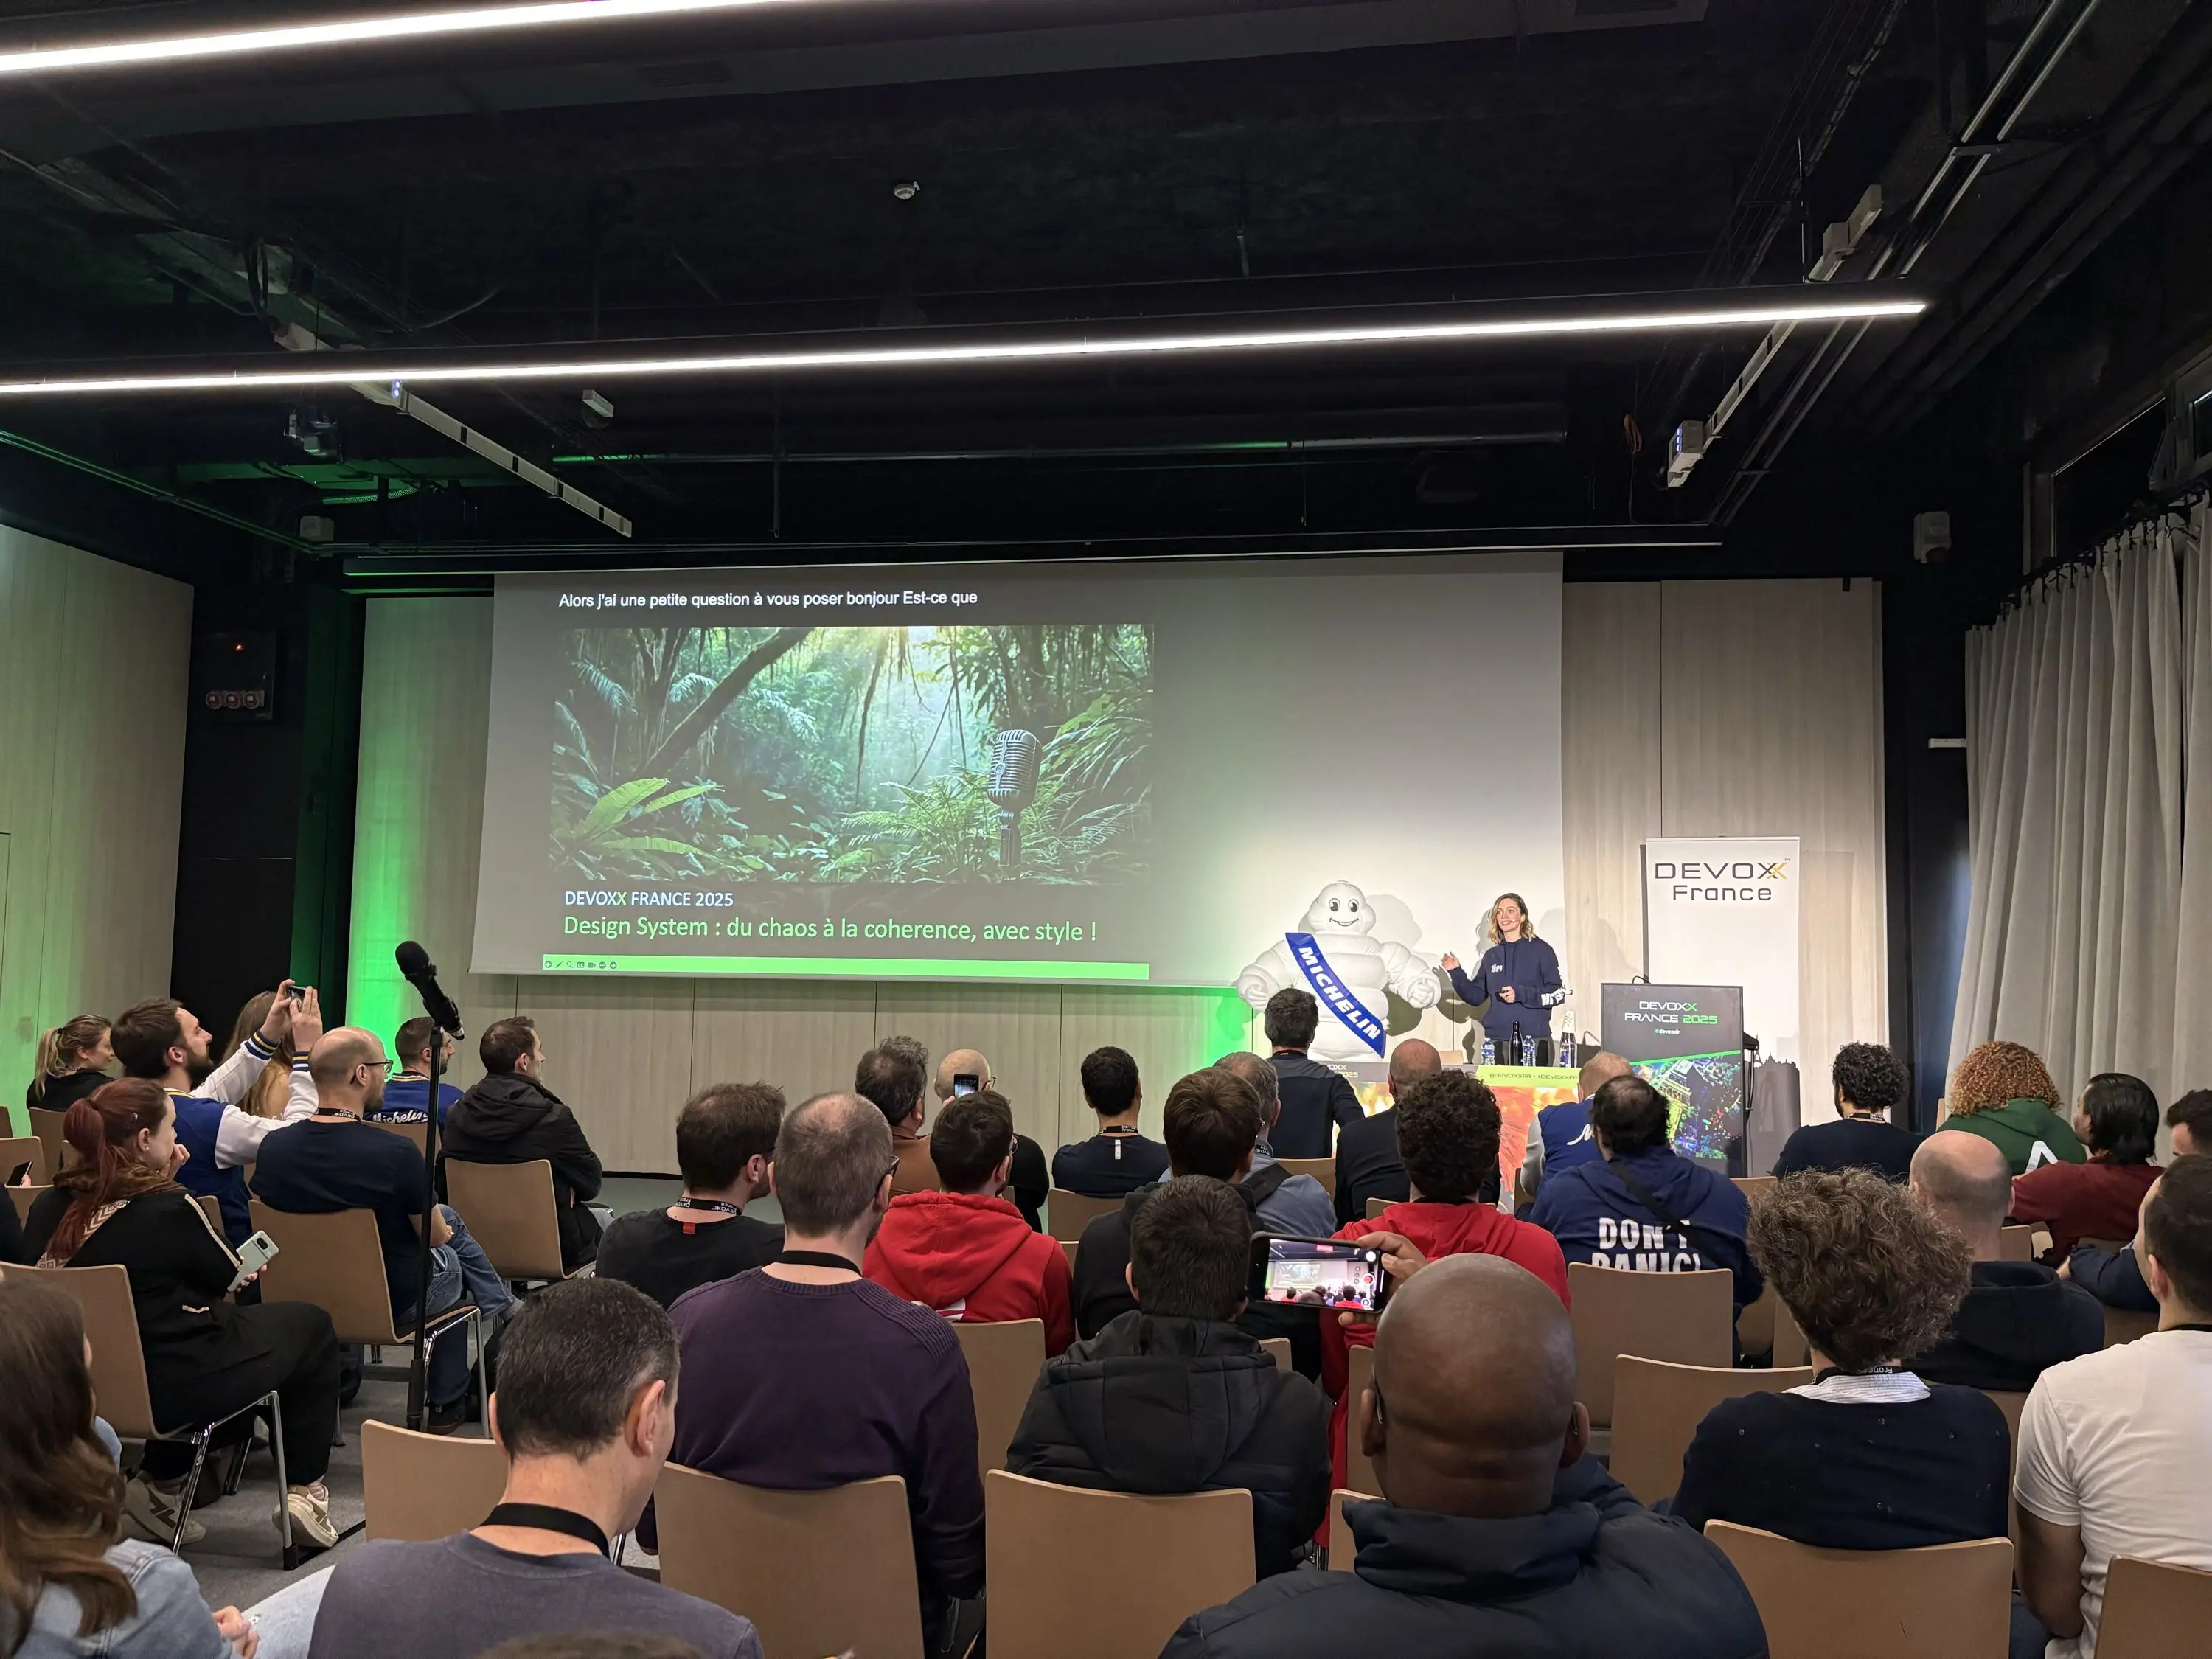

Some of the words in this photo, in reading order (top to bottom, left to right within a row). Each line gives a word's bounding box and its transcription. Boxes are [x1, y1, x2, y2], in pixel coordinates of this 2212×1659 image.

[559, 594, 594, 607] Alors
[597, 593, 616, 610] j'ai
[620, 596, 646, 607] une
[650, 593, 687, 609] petite
[692, 592, 750, 609] question
[754, 592, 762, 605] à
[767, 594, 800, 605] vous
[804, 594, 842, 608] poser
[847, 591, 900, 608] bonjour
[903, 591, 947, 605] Est-ce
[951, 592, 978, 607] que
[565, 891, 627, 906] DEVOXX
[630, 891, 692, 907] FRANCE
[695, 892, 734, 907] 2025
[1673, 885, 1772, 901] France
[564, 916, 630, 939] Design
[636, 917, 708, 940] System
[727, 917, 752, 936] du
[758, 917, 818, 937] chaos
[823, 918, 834, 938] à
[841, 918, 858, 939] la
[864, 919, 977, 943] coherence,
[983, 924, 1029, 940] avec
[1035, 921, 1082, 945] style
[1091, 921, 1096, 942] !
[1298, 947, 1380, 1040] MICHELIN
[1639, 1001, 1697, 1012] DEVOXX
[1624, 1012, 1679, 1023] FRANCE
[1683, 1015, 1718, 1024] 2025
[1599, 1217, 1691, 1249] DON
